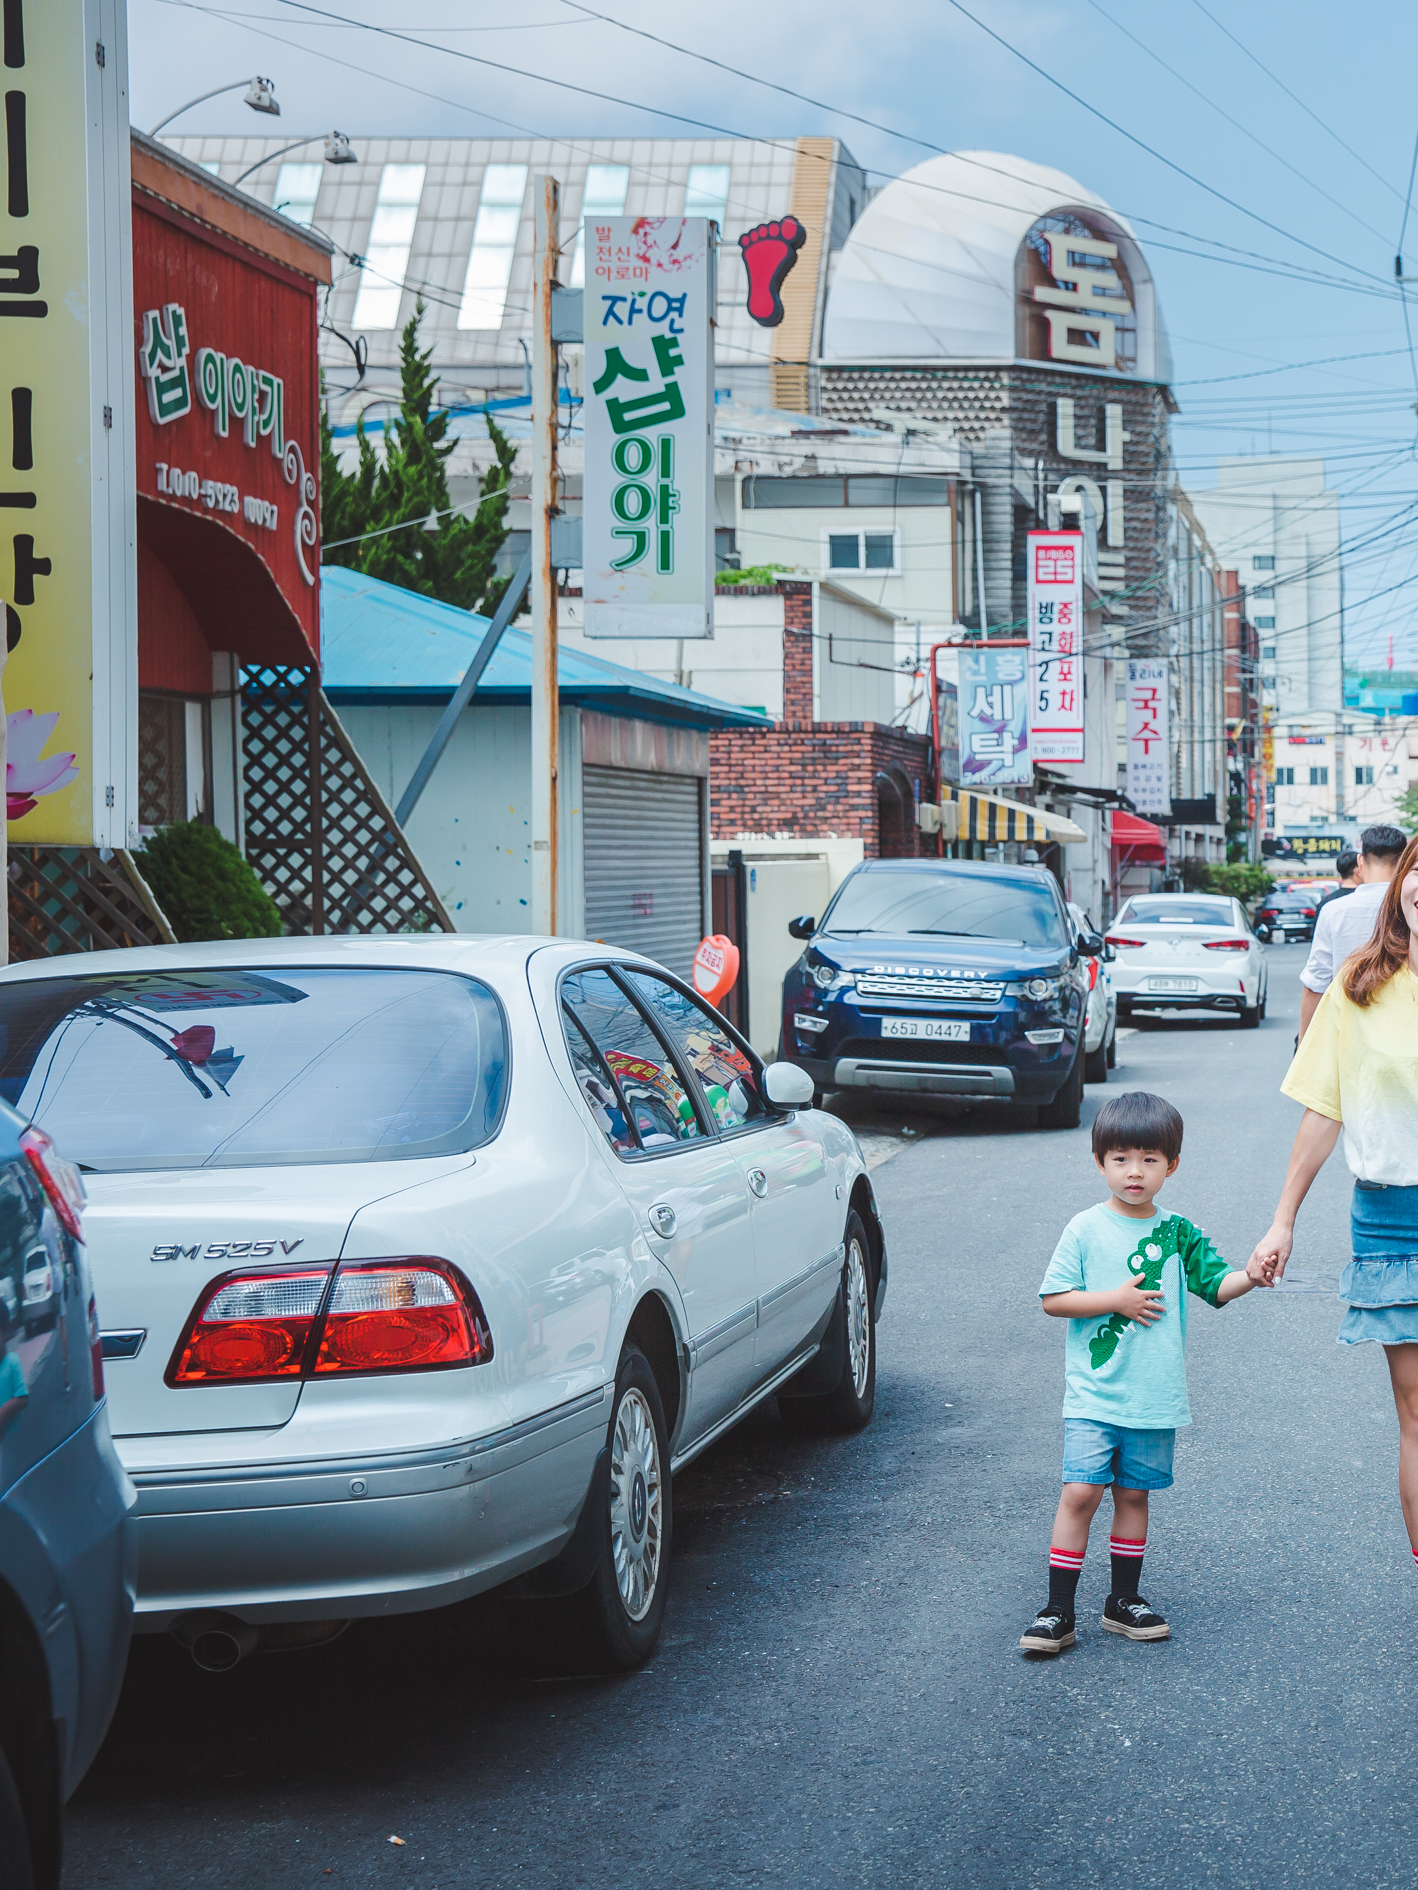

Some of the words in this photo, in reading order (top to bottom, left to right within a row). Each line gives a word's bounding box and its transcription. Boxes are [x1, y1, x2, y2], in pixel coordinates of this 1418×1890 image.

[596, 226, 612, 243] 발
[595, 266, 651, 282] 아로마
[1034, 232, 1131, 367] 돔
[601, 290, 688, 335] 자연
[139, 303, 191, 426] 샵
[195, 347, 285, 459] 이야기
[592, 334, 687, 435] 샵
[610, 433, 682, 577] 이야기
[1037, 560, 1074, 581] 25
[1057, 602, 1074, 712] 중화포차
[967, 683, 1020, 769] 세탁
[1131, 686, 1163, 756] 국수
[873, 965, 988, 979] DISCOVERY
[925, 1023, 962, 1038] 0447
